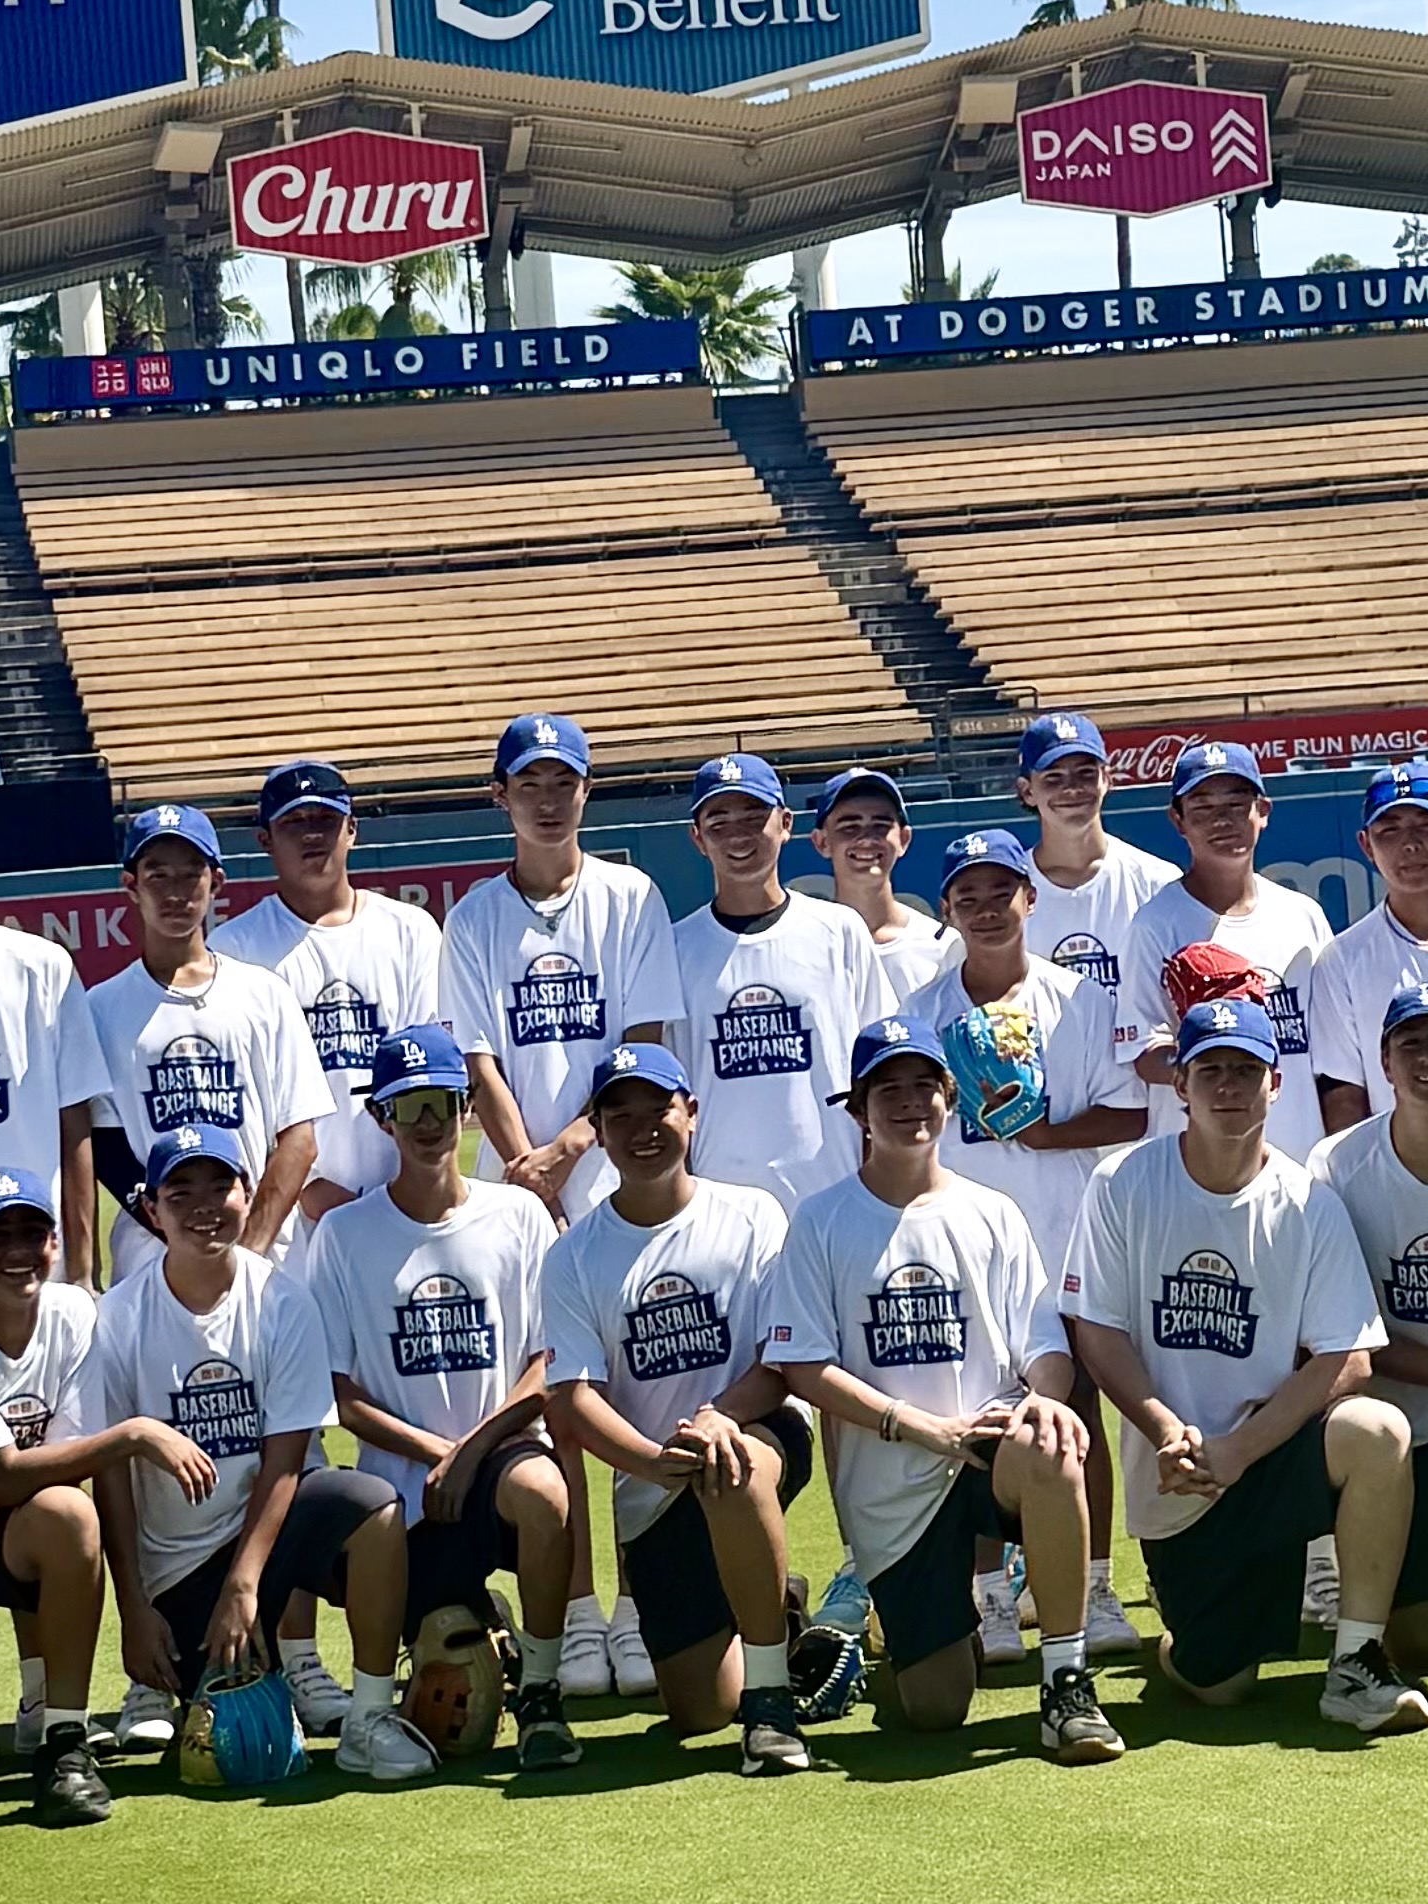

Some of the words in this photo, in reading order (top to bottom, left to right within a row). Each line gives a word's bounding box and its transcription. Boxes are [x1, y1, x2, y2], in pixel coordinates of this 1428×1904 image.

[1032, 120, 1194, 163] DAISO
[1035, 162, 1112, 183] JAPAN
[242, 165, 472, 238] Churu
[848, 313, 902, 347] AT
[939, 295, 1159, 341] DODGER
[205, 345, 425, 387] UNIQLO
[461, 334, 611, 370] FIELD
[1252, 742, 1287, 760] ME
[1298, 737, 1347, 755] RUN
[1350, 730, 1428, 753] MAGIC
[520, 980, 592, 1006] BASEBALL
[517, 1005, 600, 1037] EXCHANGE
[723, 1012, 797, 1041] BASEBALL
[719, 1037, 806, 1071] EXCHANGE
[157, 1065, 230, 1090] BASEBALL
[153, 1091, 238, 1124] EXCHANGE
[878, 1297, 957, 1324] BASEBALL
[1170, 1281, 1242, 1315] BASEBALL
[404, 1305, 480, 1334] BASEBALL
[634, 1305, 712, 1340] BASEBALL
[1160, 1309, 1248, 1351] EXCHANGE
[399, 1332, 489, 1367] EXCHANGE
[632, 1327, 725, 1372] EXCHANGE
[874, 1323, 963, 1357] EXCHANGE
[178, 1388, 254, 1422] BASEBALL
